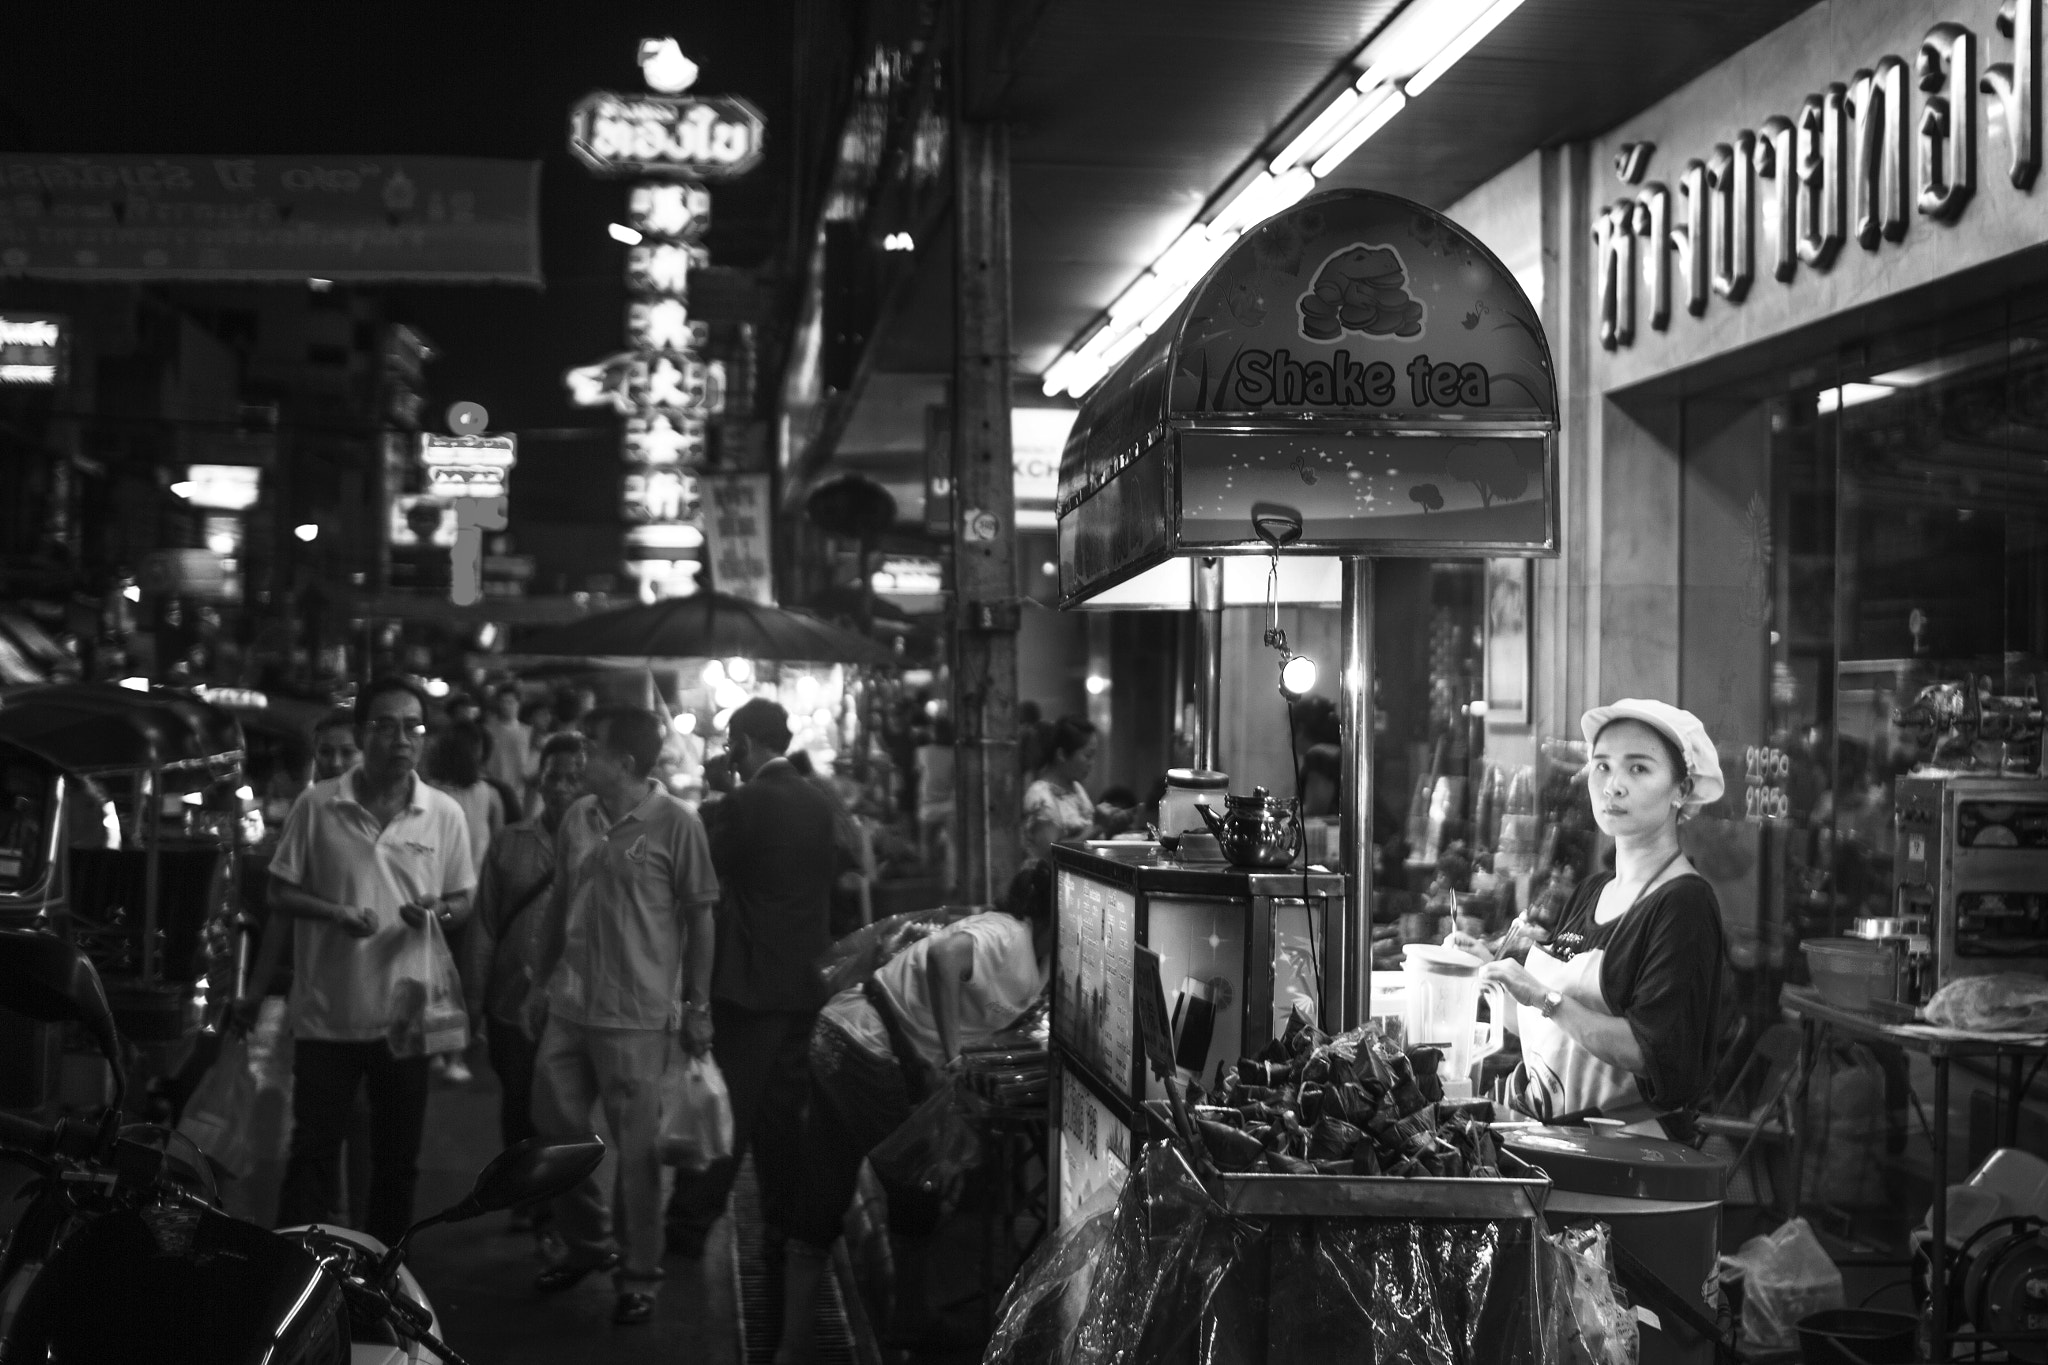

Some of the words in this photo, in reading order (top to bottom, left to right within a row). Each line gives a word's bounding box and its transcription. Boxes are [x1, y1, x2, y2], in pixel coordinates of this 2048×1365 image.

[1591, 0, 2043, 352] ห้างขายทอง
[1235, 349, 1395, 407] Shake
[1407, 354, 1490, 407] tea
